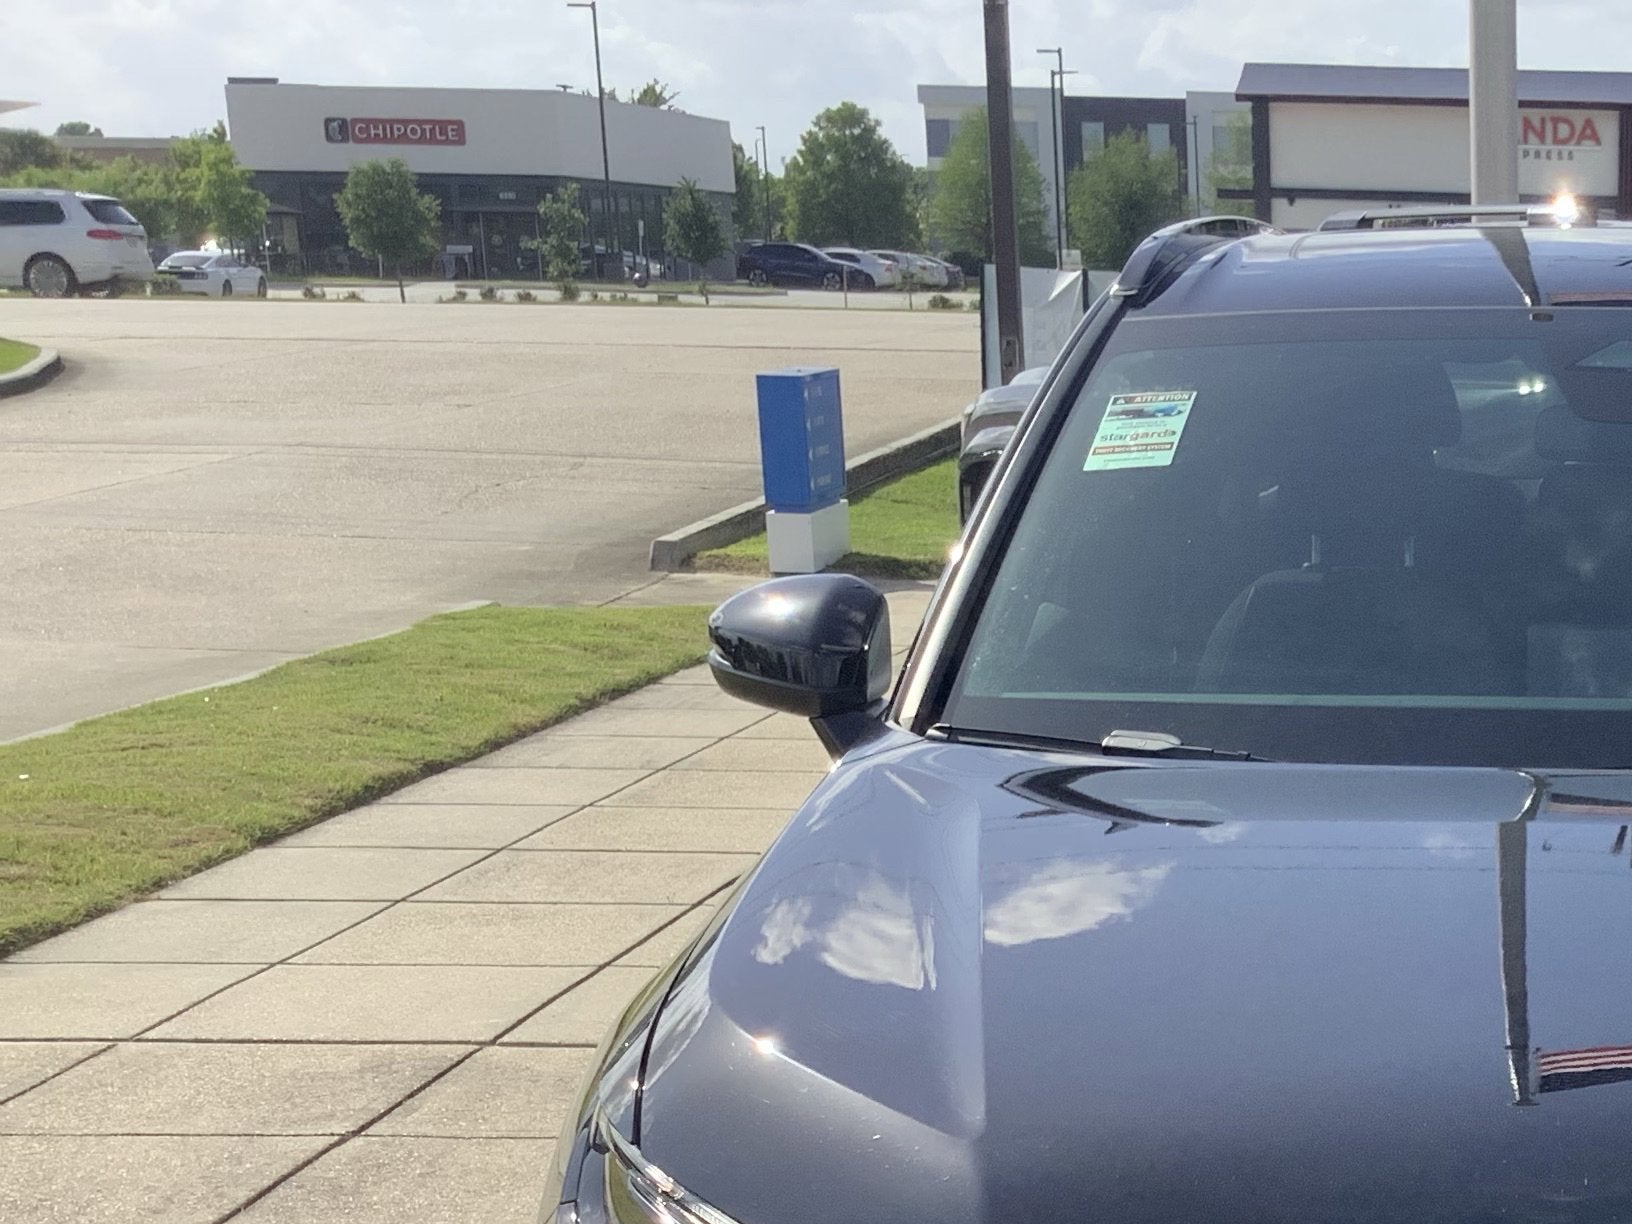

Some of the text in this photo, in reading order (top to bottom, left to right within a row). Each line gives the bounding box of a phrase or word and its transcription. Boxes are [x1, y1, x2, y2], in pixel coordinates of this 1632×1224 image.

[354, 122, 460, 142] CHIPOTLE
[1521, 115, 1602, 146] NDA
[1522, 148, 1574, 160] PRESS
[1134, 393, 1190, 403] ATTENTION
